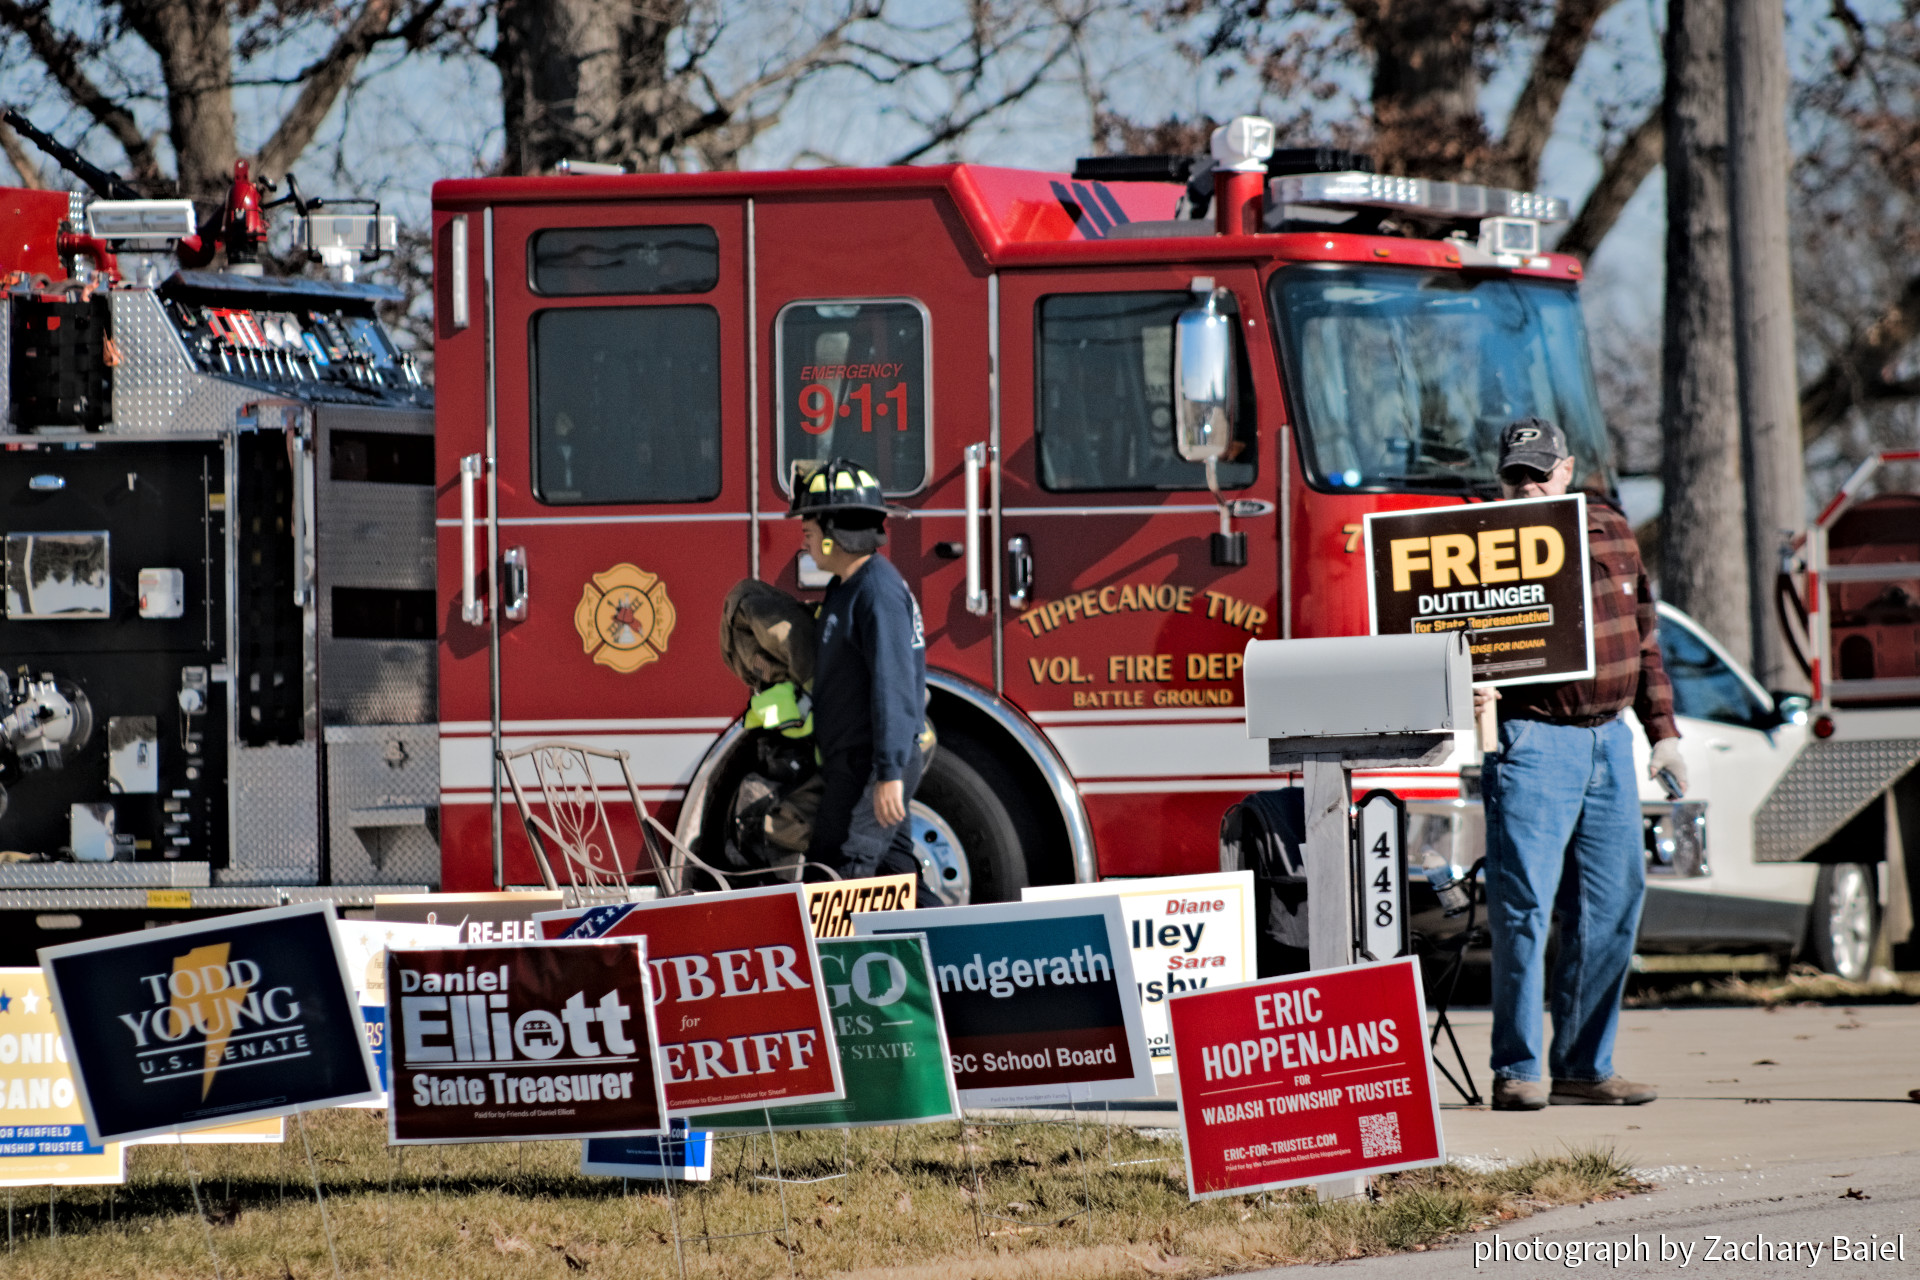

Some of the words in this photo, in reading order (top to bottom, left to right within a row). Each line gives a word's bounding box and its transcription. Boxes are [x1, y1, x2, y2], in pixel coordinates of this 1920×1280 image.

[801, 363, 903, 380] EMERGENCY
[1390, 525, 1565, 592] FRED
[1020, 583, 1195, 638] TIPPECANOE
[1205, 590, 1269, 634] TWP.
[1418, 584, 1545, 615] DUTTLINGER
[1415, 622, 1433, 633] for
[1434, 618, 1466, 632] State
[1467, 611, 1549, 629] Representative
[1494, 641, 1511, 652] FOR
[1512, 638, 1546, 650] INDIANA
[1028, 656, 1094, 684] VOL.
[1108, 654, 1173, 682] FIRE
[1073, 689, 1144, 708] BATTLE
[1153, 688, 1234, 707] GROUND
[1166, 899, 1225, 915] Diane
[468, 920, 537, 943] RE-ELE
[565, 917, 597, 939] CT
[937, 945, 1111, 998] ndgerath
[1167, 955, 1226, 971] Sara
[140, 959, 260, 1004] TODD
[400, 965, 509, 994] Daniel
[1137, 972, 1208, 1006] sby
[118, 986, 301, 1047] YOUNG
[1254, 987, 1323, 1030] ERIC
[401, 988, 636, 1063] Elliott
[680, 1015, 700, 1031] for
[834, 1014, 874, 1036] ES
[139, 1055, 193, 1075] U.S.
[208, 1034, 310, 1061] SENATE
[658, 1028, 816, 1085] ERIFF
[851, 1042, 916, 1059] STATE
[983, 1048, 1051, 1071] School
[1056, 1043, 1116, 1067] Board
[1201, 1018, 1400, 1082] HOPPENJANS
[412, 1073, 486, 1106] State
[489, 1072, 633, 1105] Treasurer
[1294, 1074, 1311, 1087] FOR
[488, 1110, 497, 1118] for
[498, 1111, 506, 1119] by
[506, 1110, 529, 1118] Friends
[530, 1109, 537, 1117] of
[537, 1109, 557, 1117] Daniel
[557, 1108, 576, 1116] Elliott
[669, 1098, 700, 1107] Committee
[1201, 1100, 1264, 1126] WABASH
[1266, 1088, 1343, 1116] TOWNSHIP
[1345, 1077, 1413, 1103] TRUSTEE
[17, 1126, 72, 1138] FAIRFIELD
[38, 1140, 84, 1153] TRUSTEE
[1224, 1133, 1338, 1162] ERIC-FOR-TRUSTEE.COM
[1262, 1157, 1291, 1166] Committee
[1296, 1154, 1310, 1162] Elect
[1320, 1148, 1351, 1158] Hoppenjans
